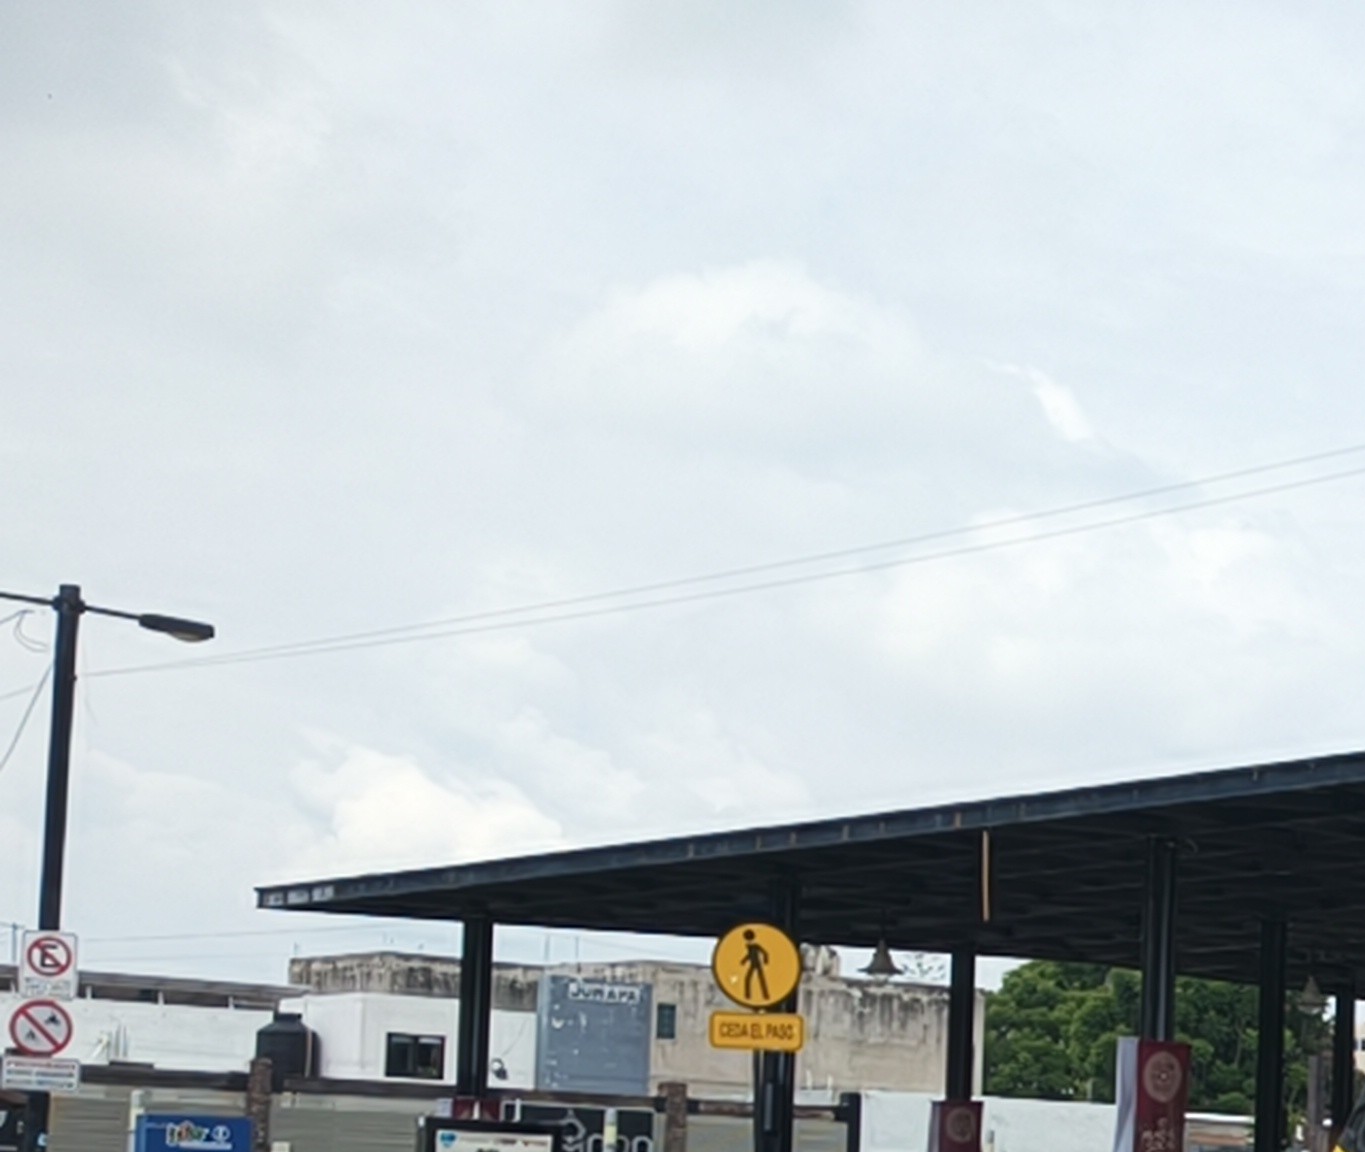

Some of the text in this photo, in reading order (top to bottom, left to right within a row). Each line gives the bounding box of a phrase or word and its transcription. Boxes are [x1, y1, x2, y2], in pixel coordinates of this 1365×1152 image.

[720, 1022, 795, 1040] CEDA EL PASO
